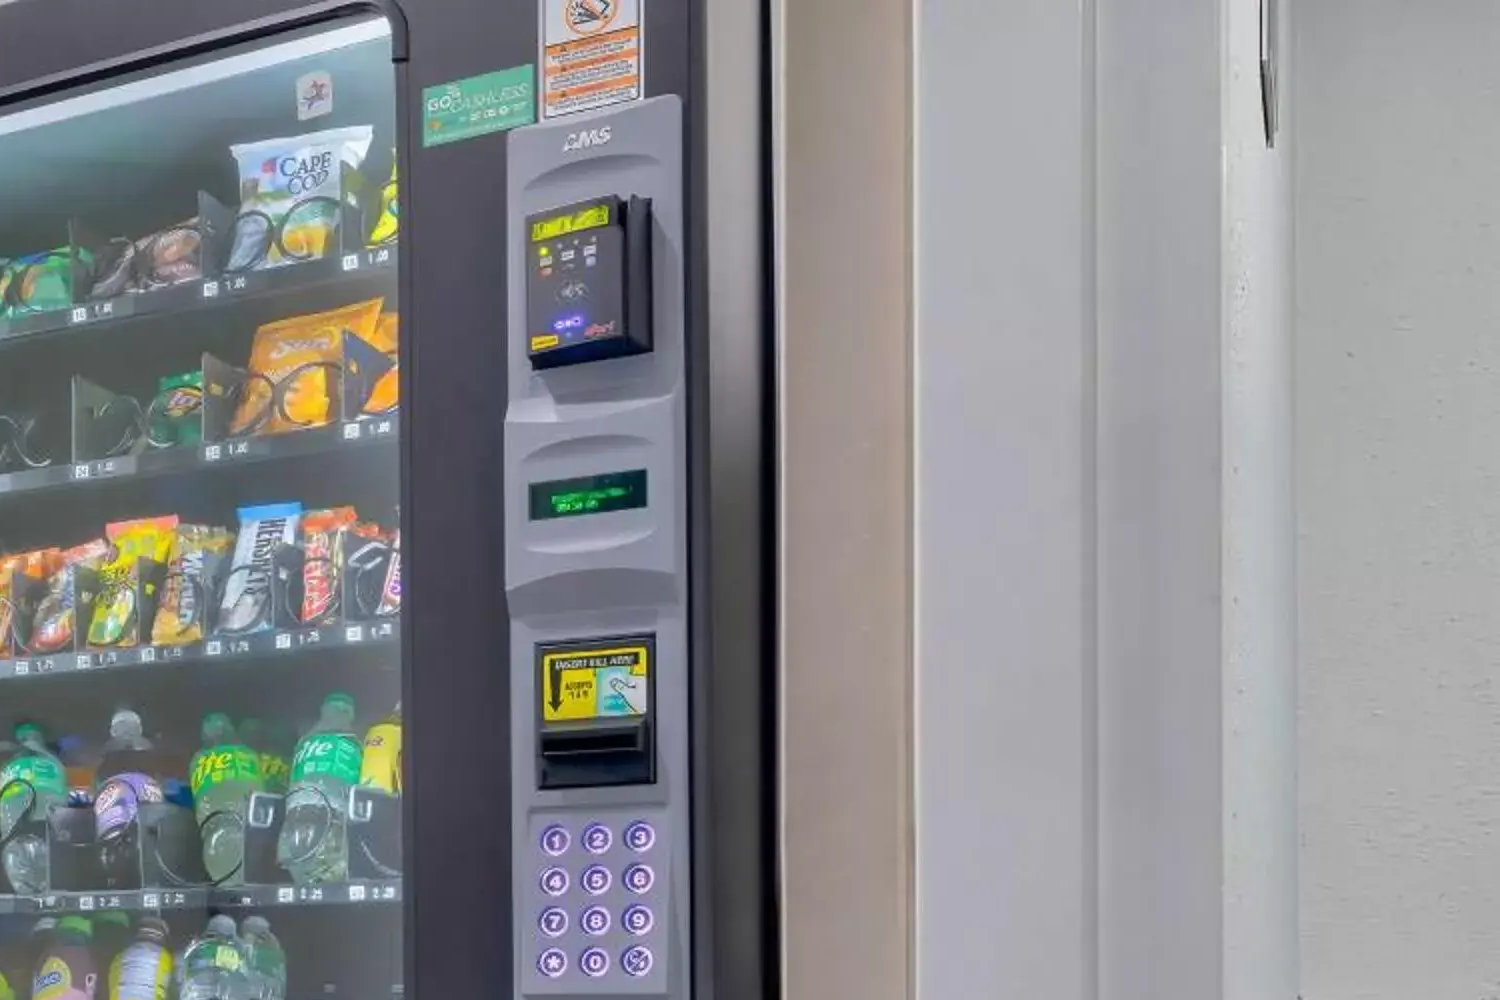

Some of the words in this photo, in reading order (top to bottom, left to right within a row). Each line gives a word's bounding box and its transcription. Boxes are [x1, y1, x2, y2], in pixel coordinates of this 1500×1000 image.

[427, 95, 451, 112] GO
[562, 126, 613, 152] AMS
[280, 151, 332, 177] CAPE
[287, 170, 330, 195] COD
